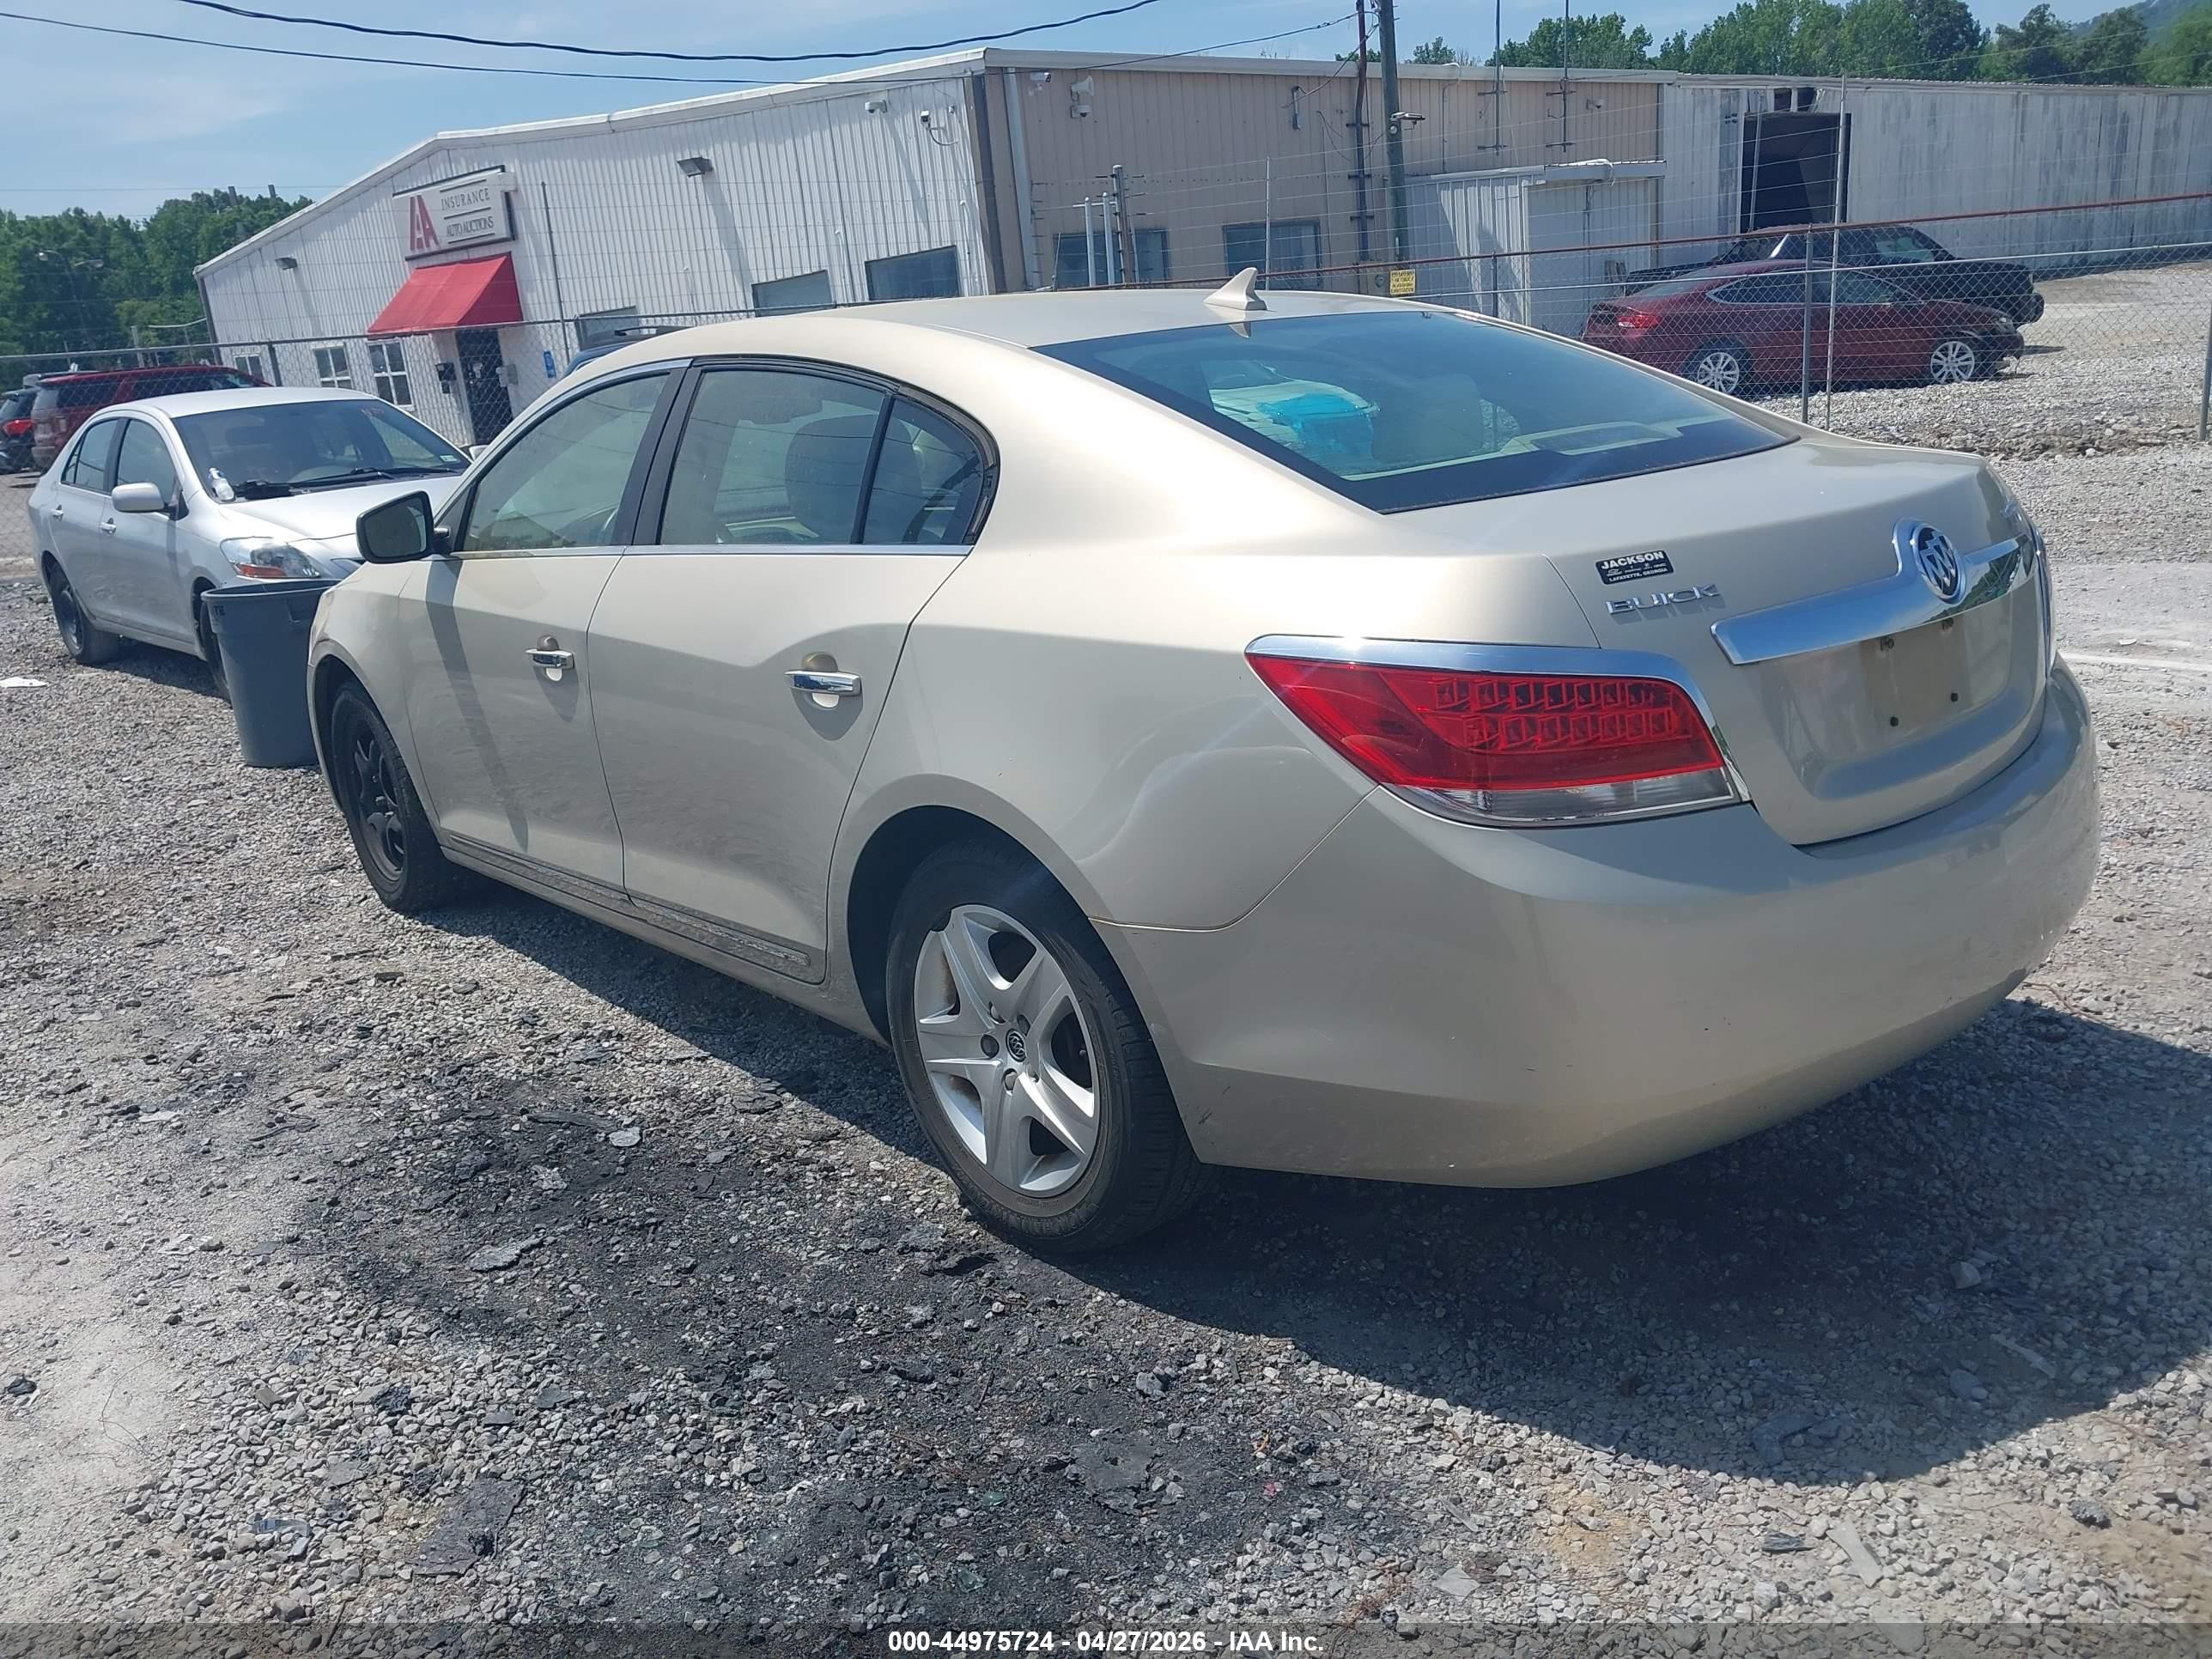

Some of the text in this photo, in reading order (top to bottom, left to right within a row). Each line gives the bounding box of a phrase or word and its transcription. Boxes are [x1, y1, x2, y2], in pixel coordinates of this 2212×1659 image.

[441, 188, 489, 210] INSURANCE
[447, 222, 463, 237] AUTO
[1601, 550, 1665, 569] JACKSON
[1605, 583, 1720, 615] BUICK
